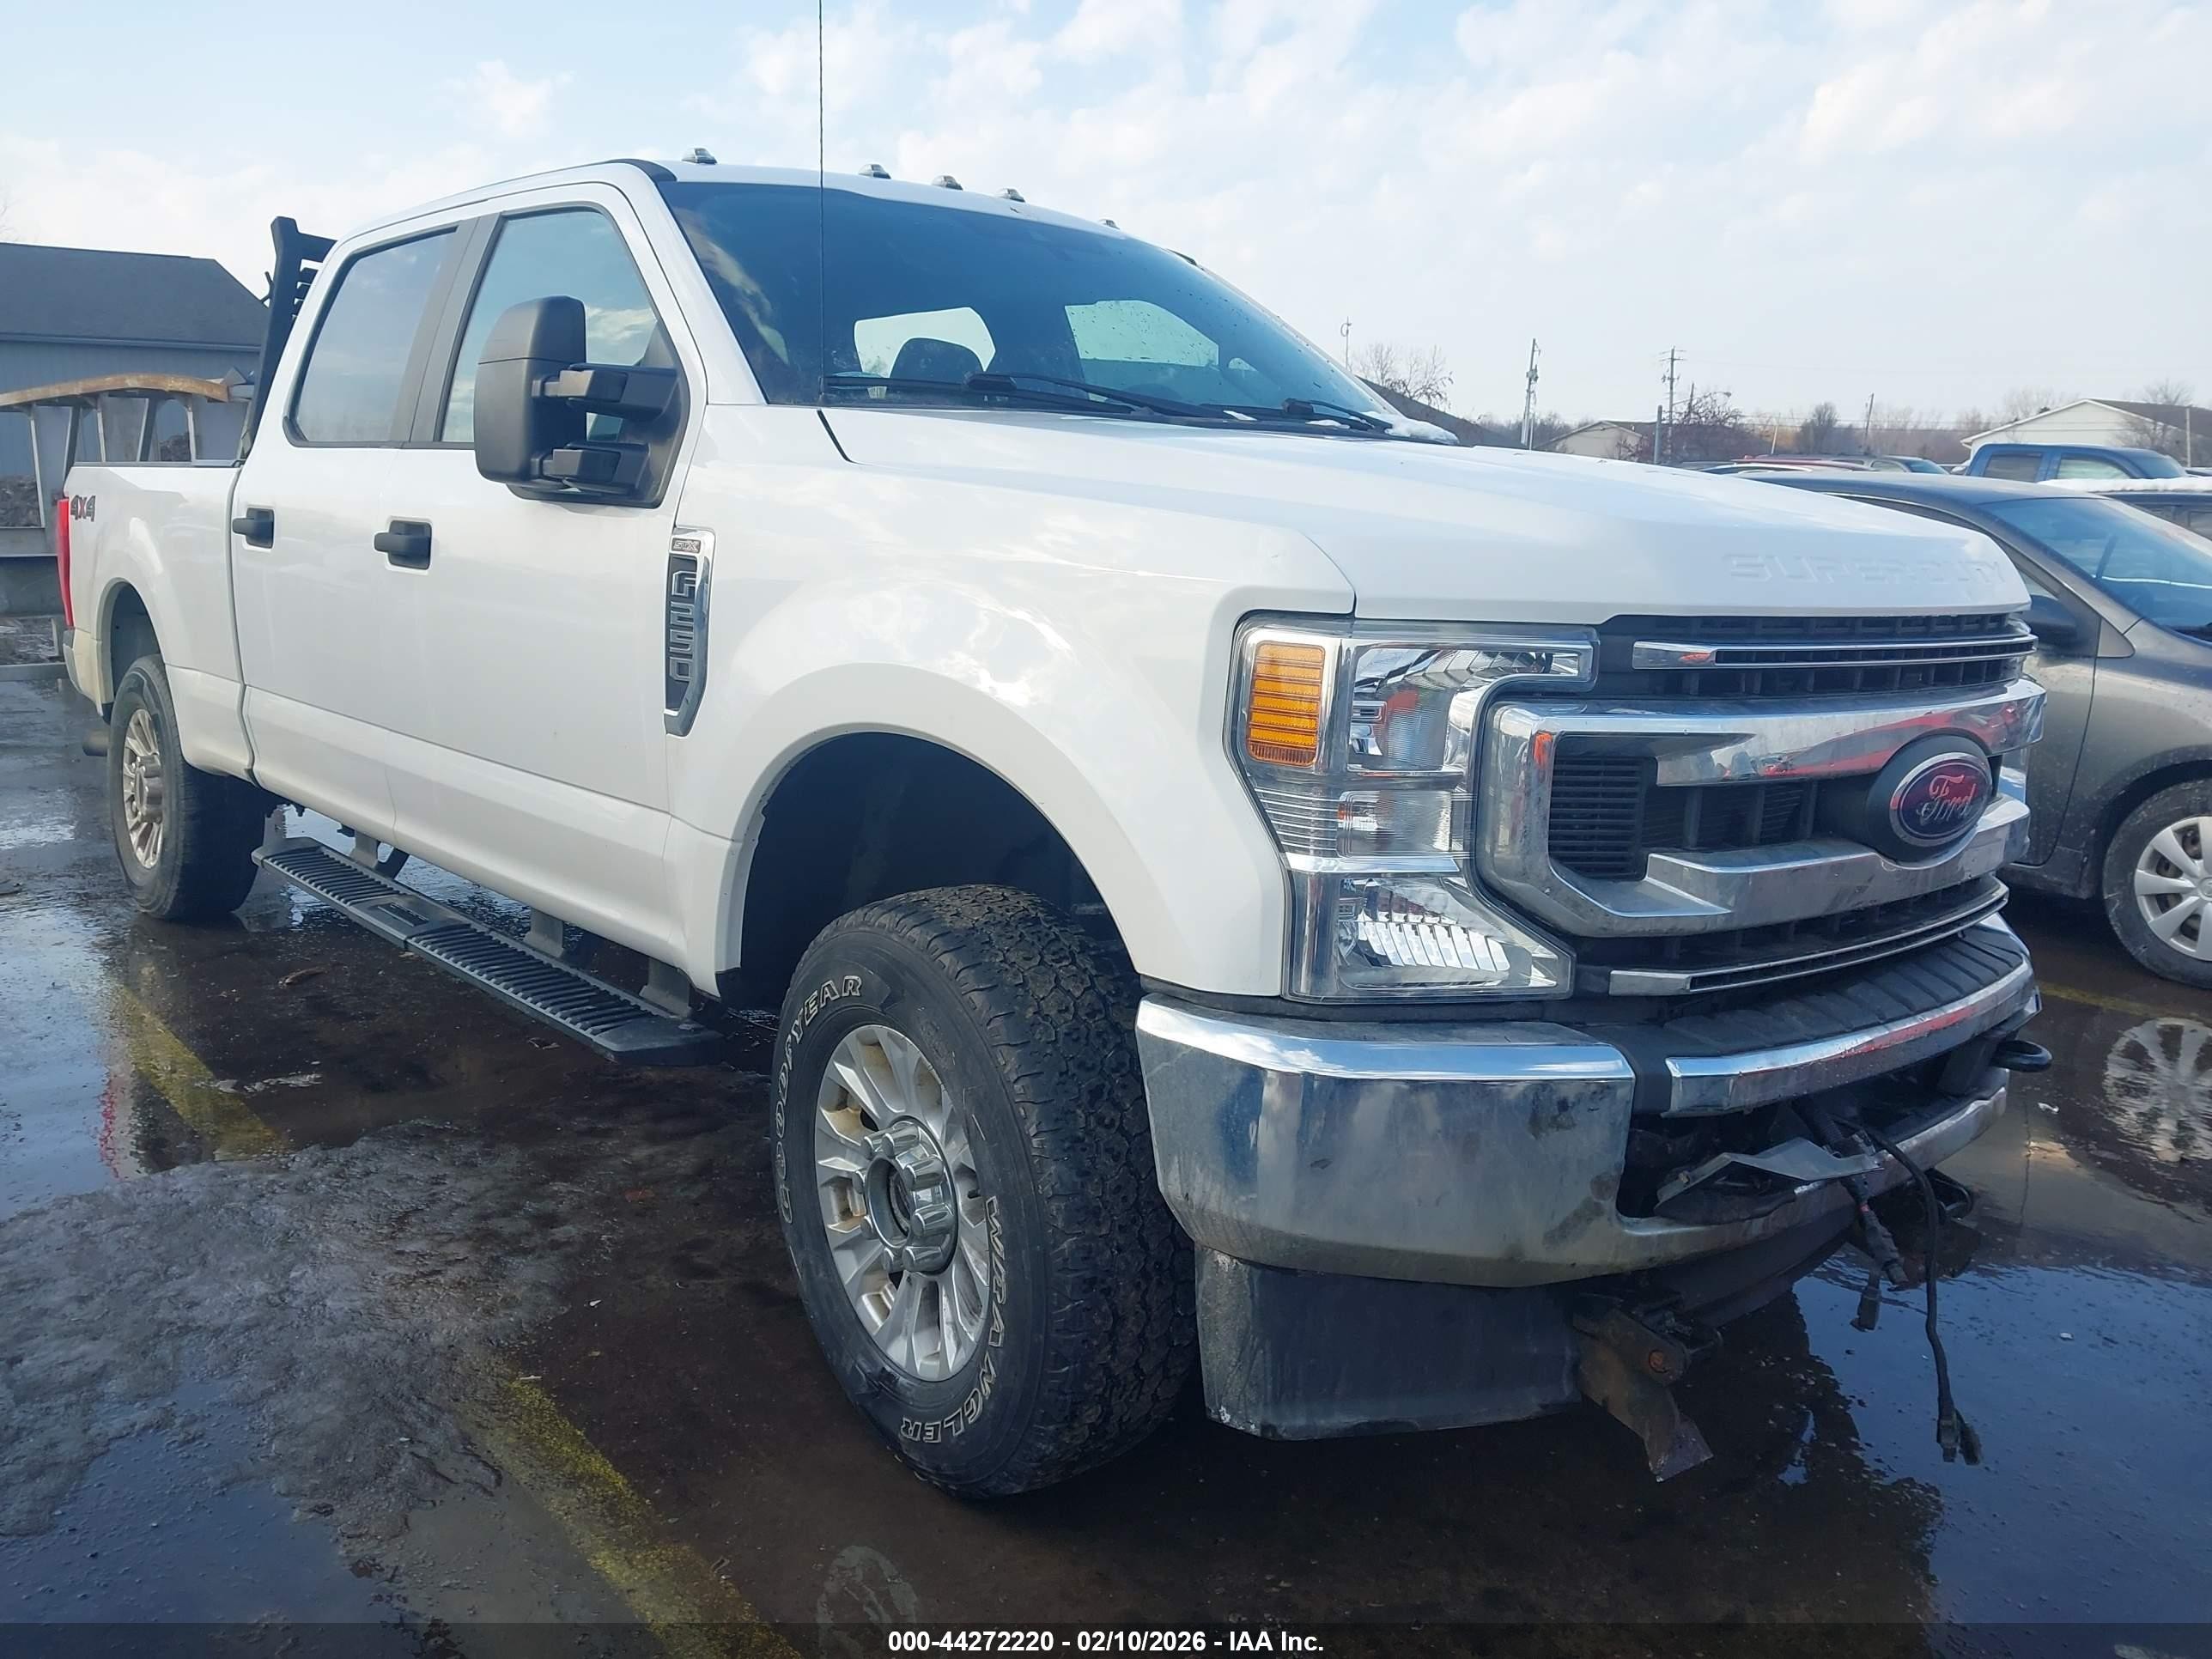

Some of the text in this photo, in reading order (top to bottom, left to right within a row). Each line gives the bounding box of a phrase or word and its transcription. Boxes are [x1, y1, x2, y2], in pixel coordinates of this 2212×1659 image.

[672, 539, 699, 553] STX
[1916, 774, 1977, 827] Ford
[775, 975, 863, 1224] GOODYEAR
[900, 1195, 1008, 1444] WRANGLER
